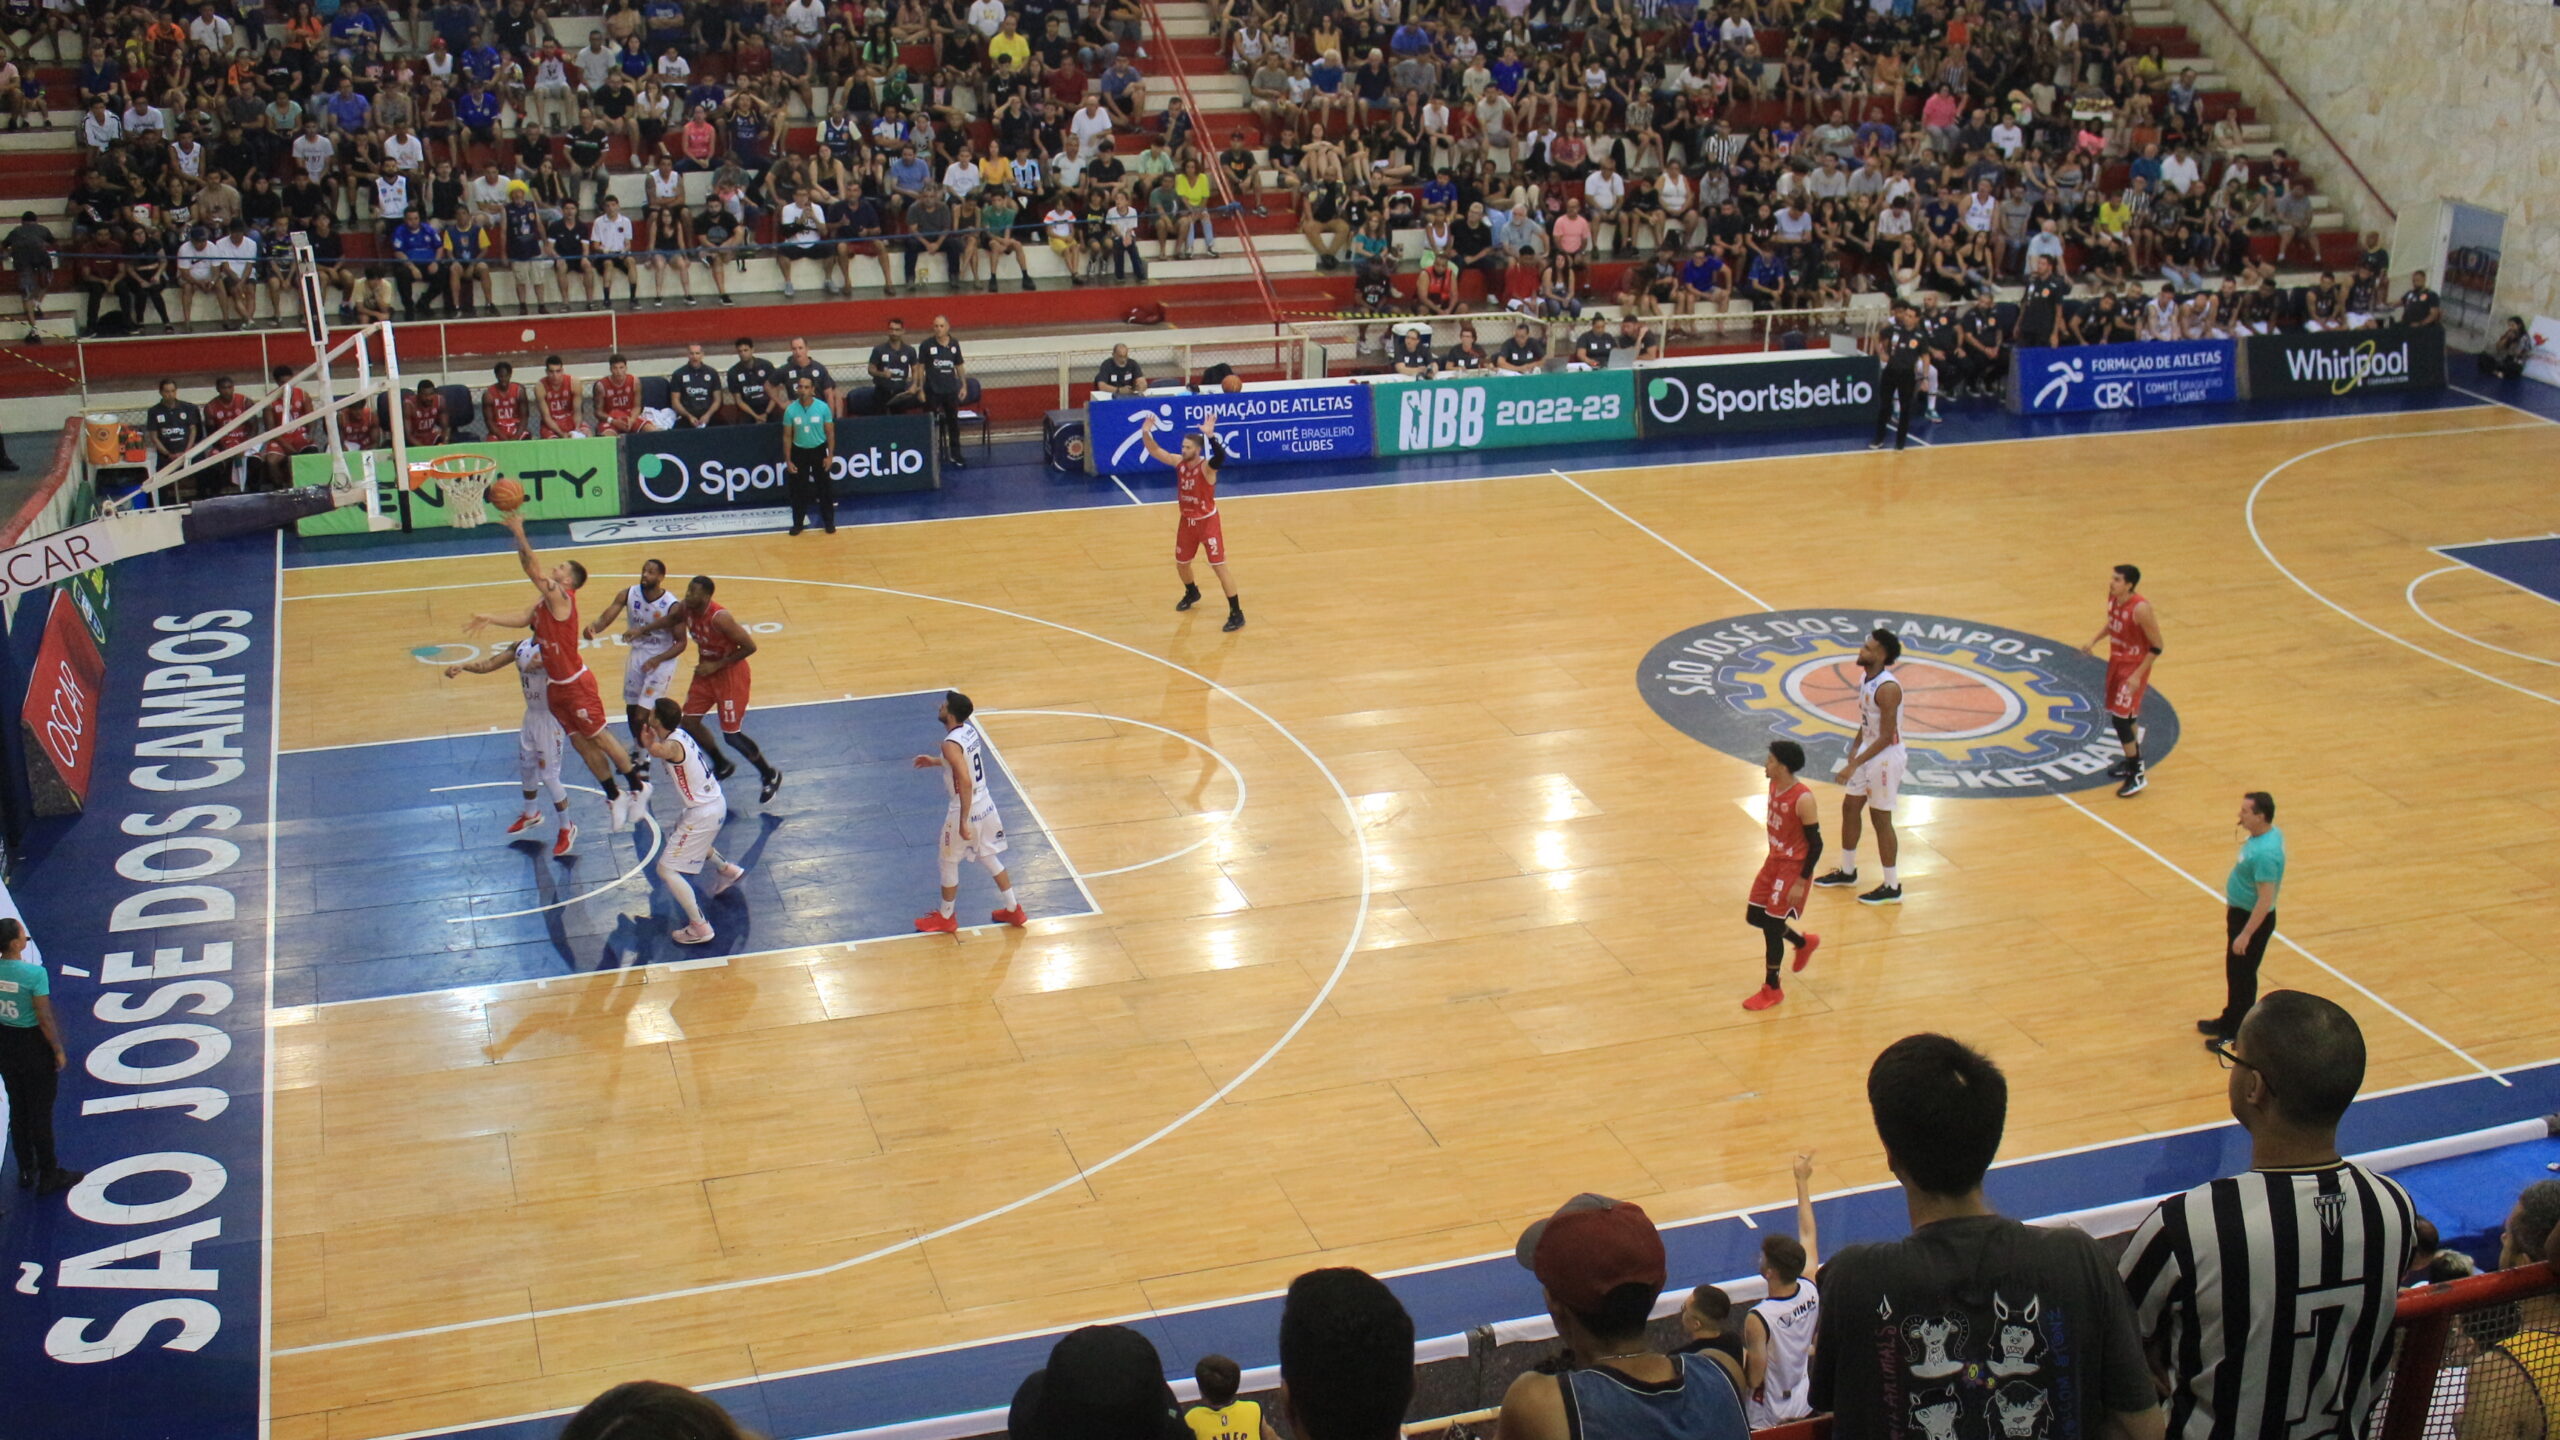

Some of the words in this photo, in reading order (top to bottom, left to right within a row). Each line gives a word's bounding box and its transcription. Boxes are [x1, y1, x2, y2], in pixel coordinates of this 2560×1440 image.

[2092, 355, 2154, 373] FORMAÇÃO
[2155, 355, 2172, 369] DE
[2172, 350, 2222, 367] ATLETAS
[2286, 342, 2408, 387] Whirlpool
[1184, 399, 1267, 420] FORMAÇÃO
[1270, 400, 1289, 414] DE
[1291, 396, 1353, 412] ATLETAS
[1696, 375, 1872, 420] Sportsbet.io
[2093, 381, 2134, 409] CBC
[1256, 426, 1299, 443] COMITÊ
[1301, 425, 1355, 439] BRASILEIRO
[1398, 386, 1486, 451] NBB
[1496, 394, 1621, 426] 2022-23
[1291, 438, 1334, 453] CLUBES
[700, 442, 923, 501] Sporbet.io
[1683, 623, 1774, 662] JOSÉ
[1765, 616, 1859, 638] DOS
[1655, 660, 1716, 696] SÃO
[46, 660, 85, 768] OSCAR
[128, 609, 253, 792] CAMPOS
[723, 710, 737, 723] 11
[2115, 692, 2132, 708] 33
[973, 752, 983, 782] 9
[109, 804, 242, 936] DOS
[60, 940, 234, 1122] JOSÉ
[16, 1152, 228, 1364] SÃO
